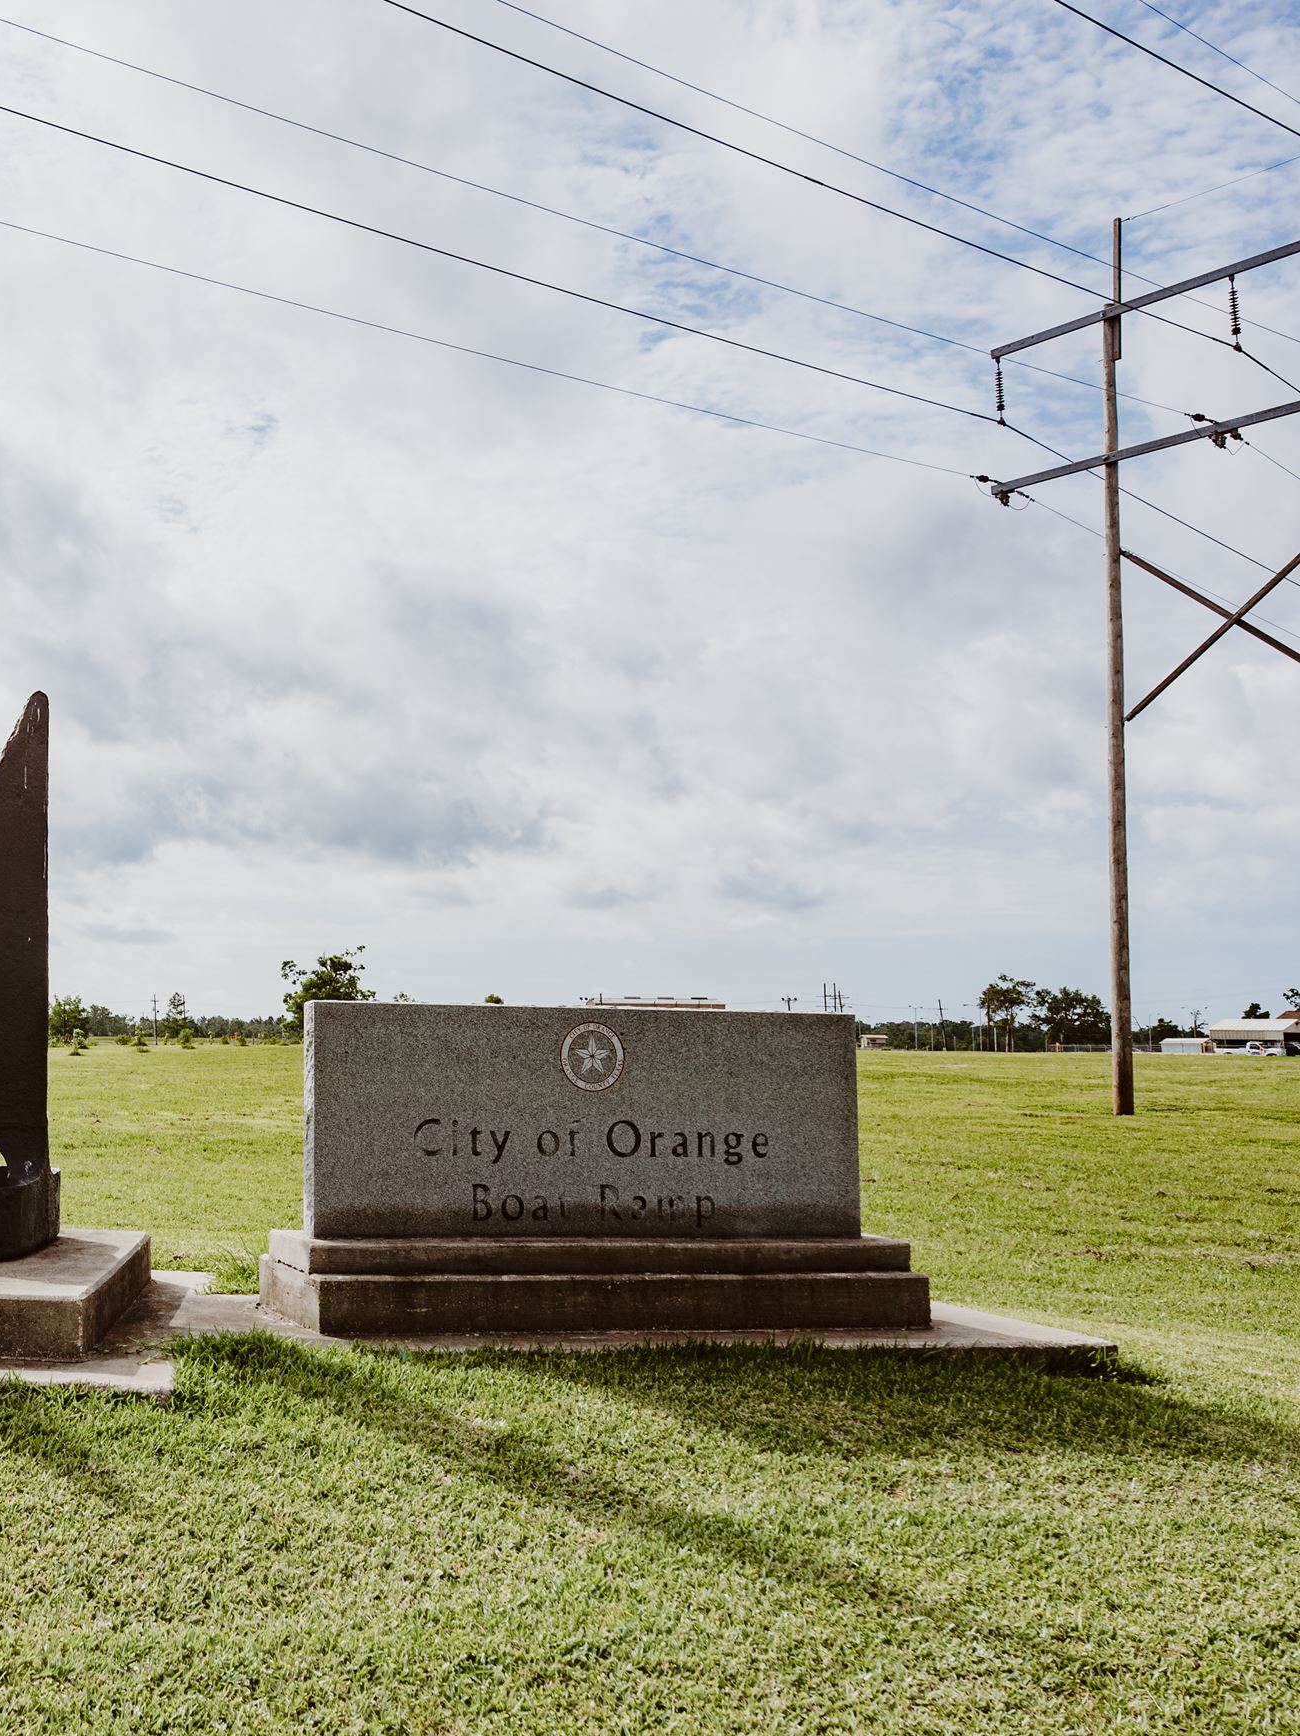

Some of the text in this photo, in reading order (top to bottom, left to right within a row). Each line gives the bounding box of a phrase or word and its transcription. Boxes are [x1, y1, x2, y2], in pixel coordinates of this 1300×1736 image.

[569, 1027, 582, 1039] CITY
[593, 1025, 615, 1039] ORANGE
[414, 1117, 770, 1165] City of Orange
[471, 1183, 716, 1228] Boat Ramp
